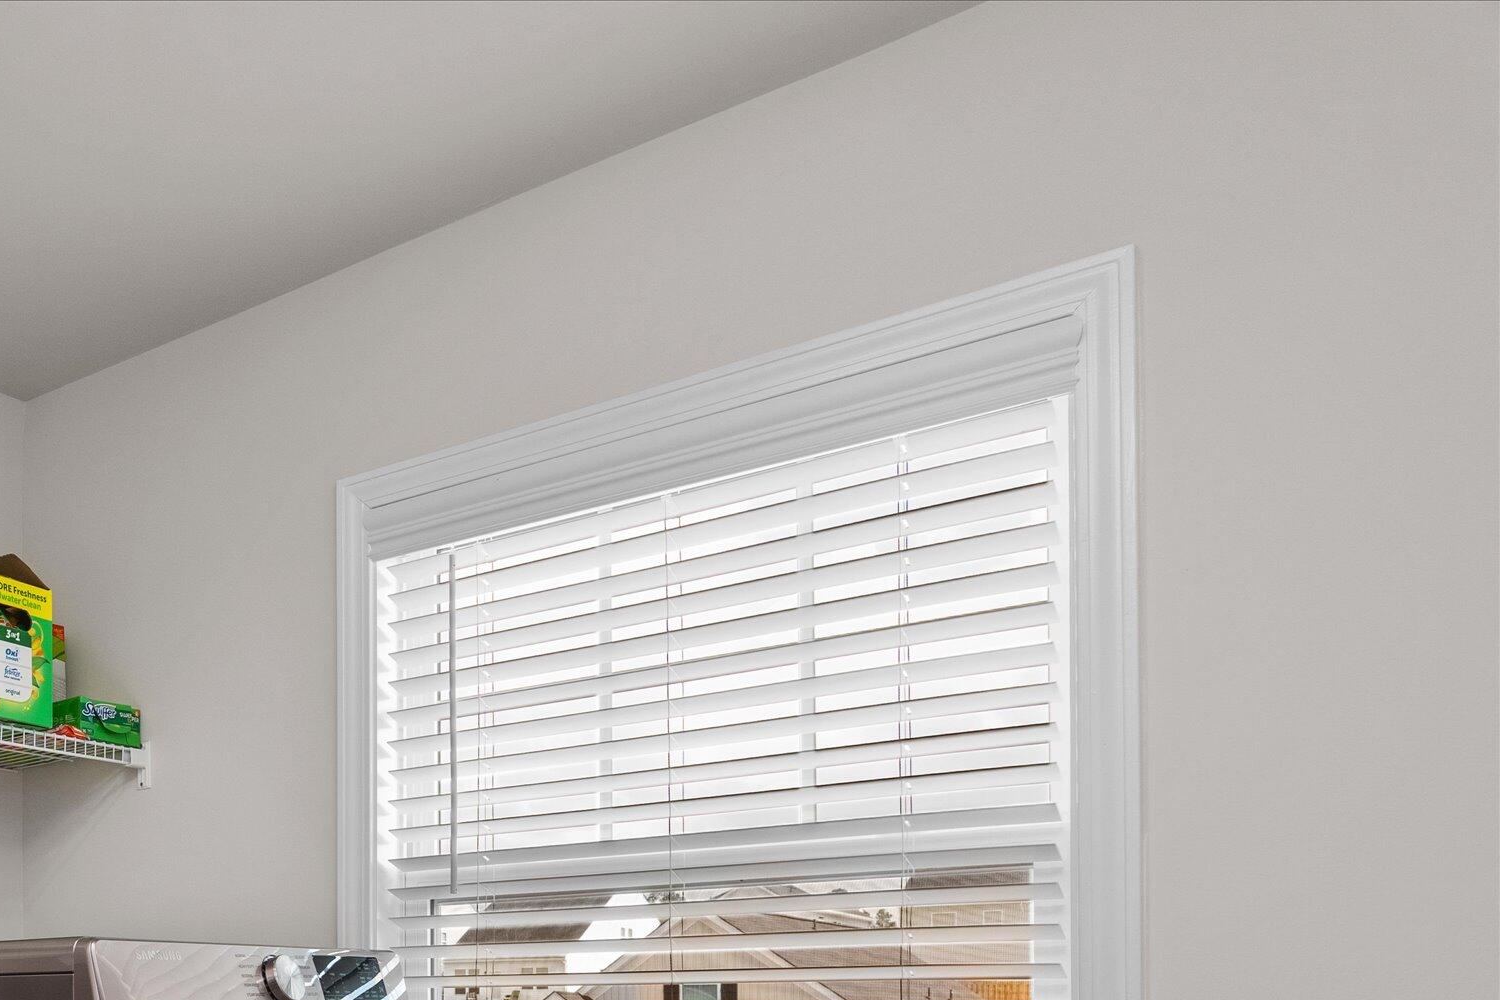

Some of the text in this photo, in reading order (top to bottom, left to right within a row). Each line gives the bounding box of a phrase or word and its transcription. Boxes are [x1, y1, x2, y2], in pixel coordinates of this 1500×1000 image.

[13, 587, 47, 603] Freshness
[21, 598, 42, 611] Clean
[5, 648, 19, 657] Oxi
